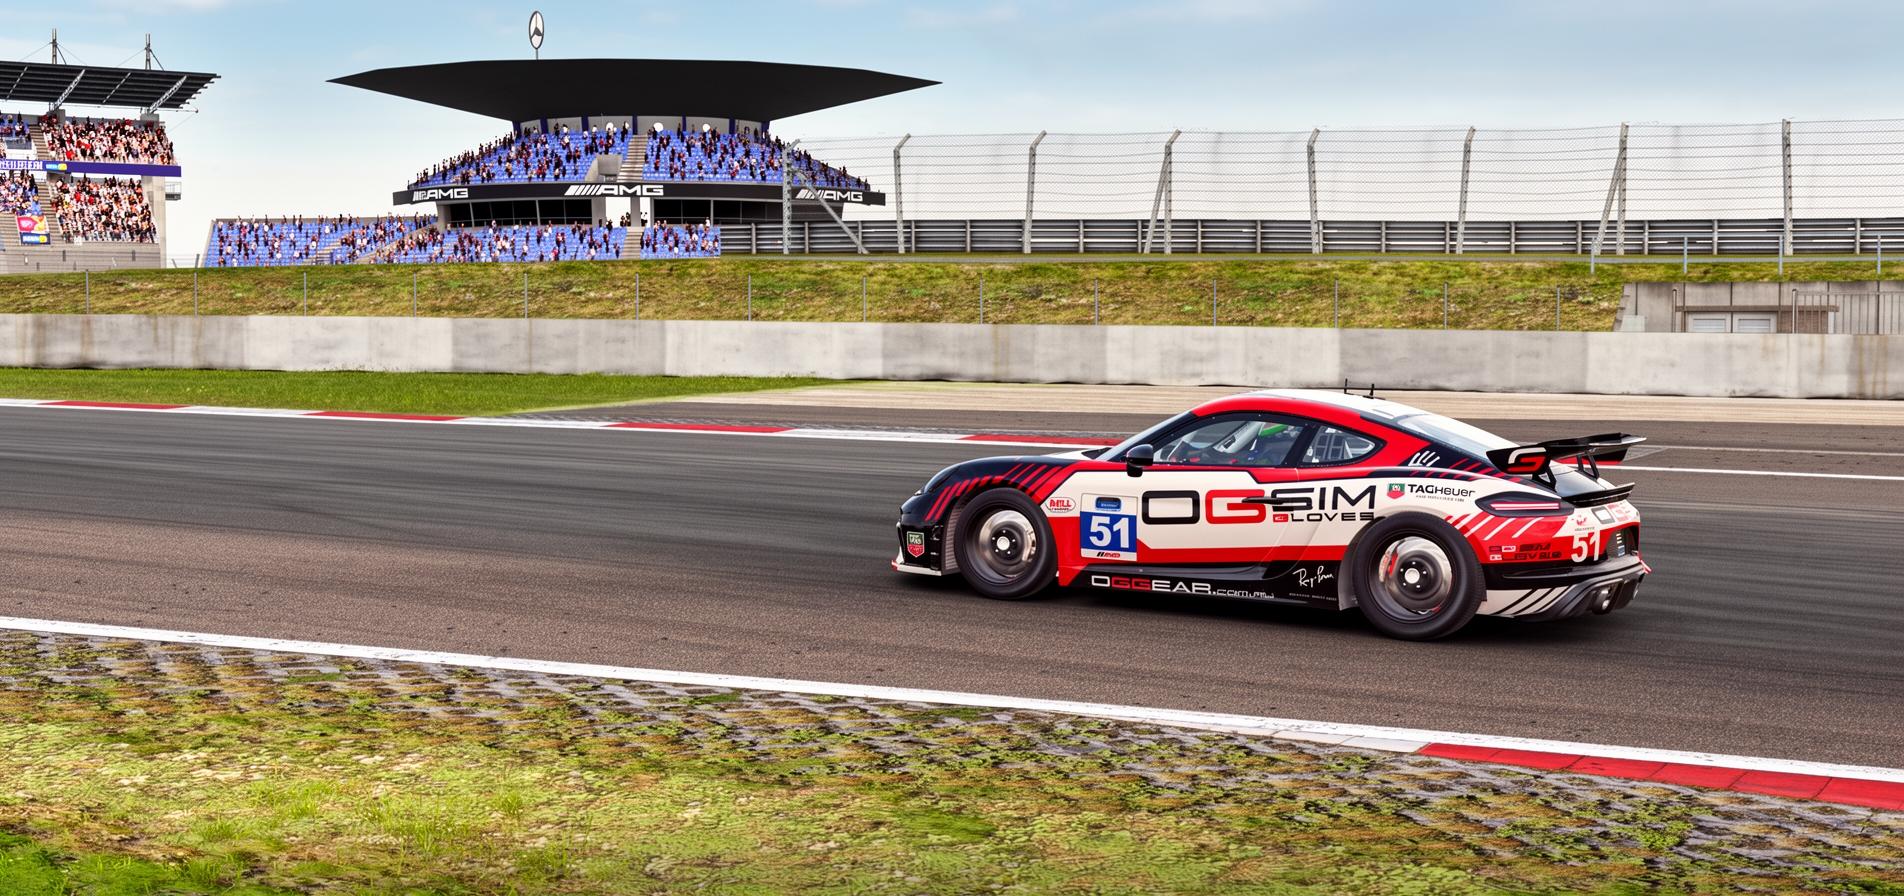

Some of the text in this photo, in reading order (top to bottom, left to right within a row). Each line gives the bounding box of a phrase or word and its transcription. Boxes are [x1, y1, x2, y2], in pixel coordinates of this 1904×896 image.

[426, 188, 469, 199] AMG
[596, 184, 664, 196] AMG
[822, 190, 863, 201] AMG
[1089, 515, 1129, 549] 51
[1571, 529, 1601, 563] 51
